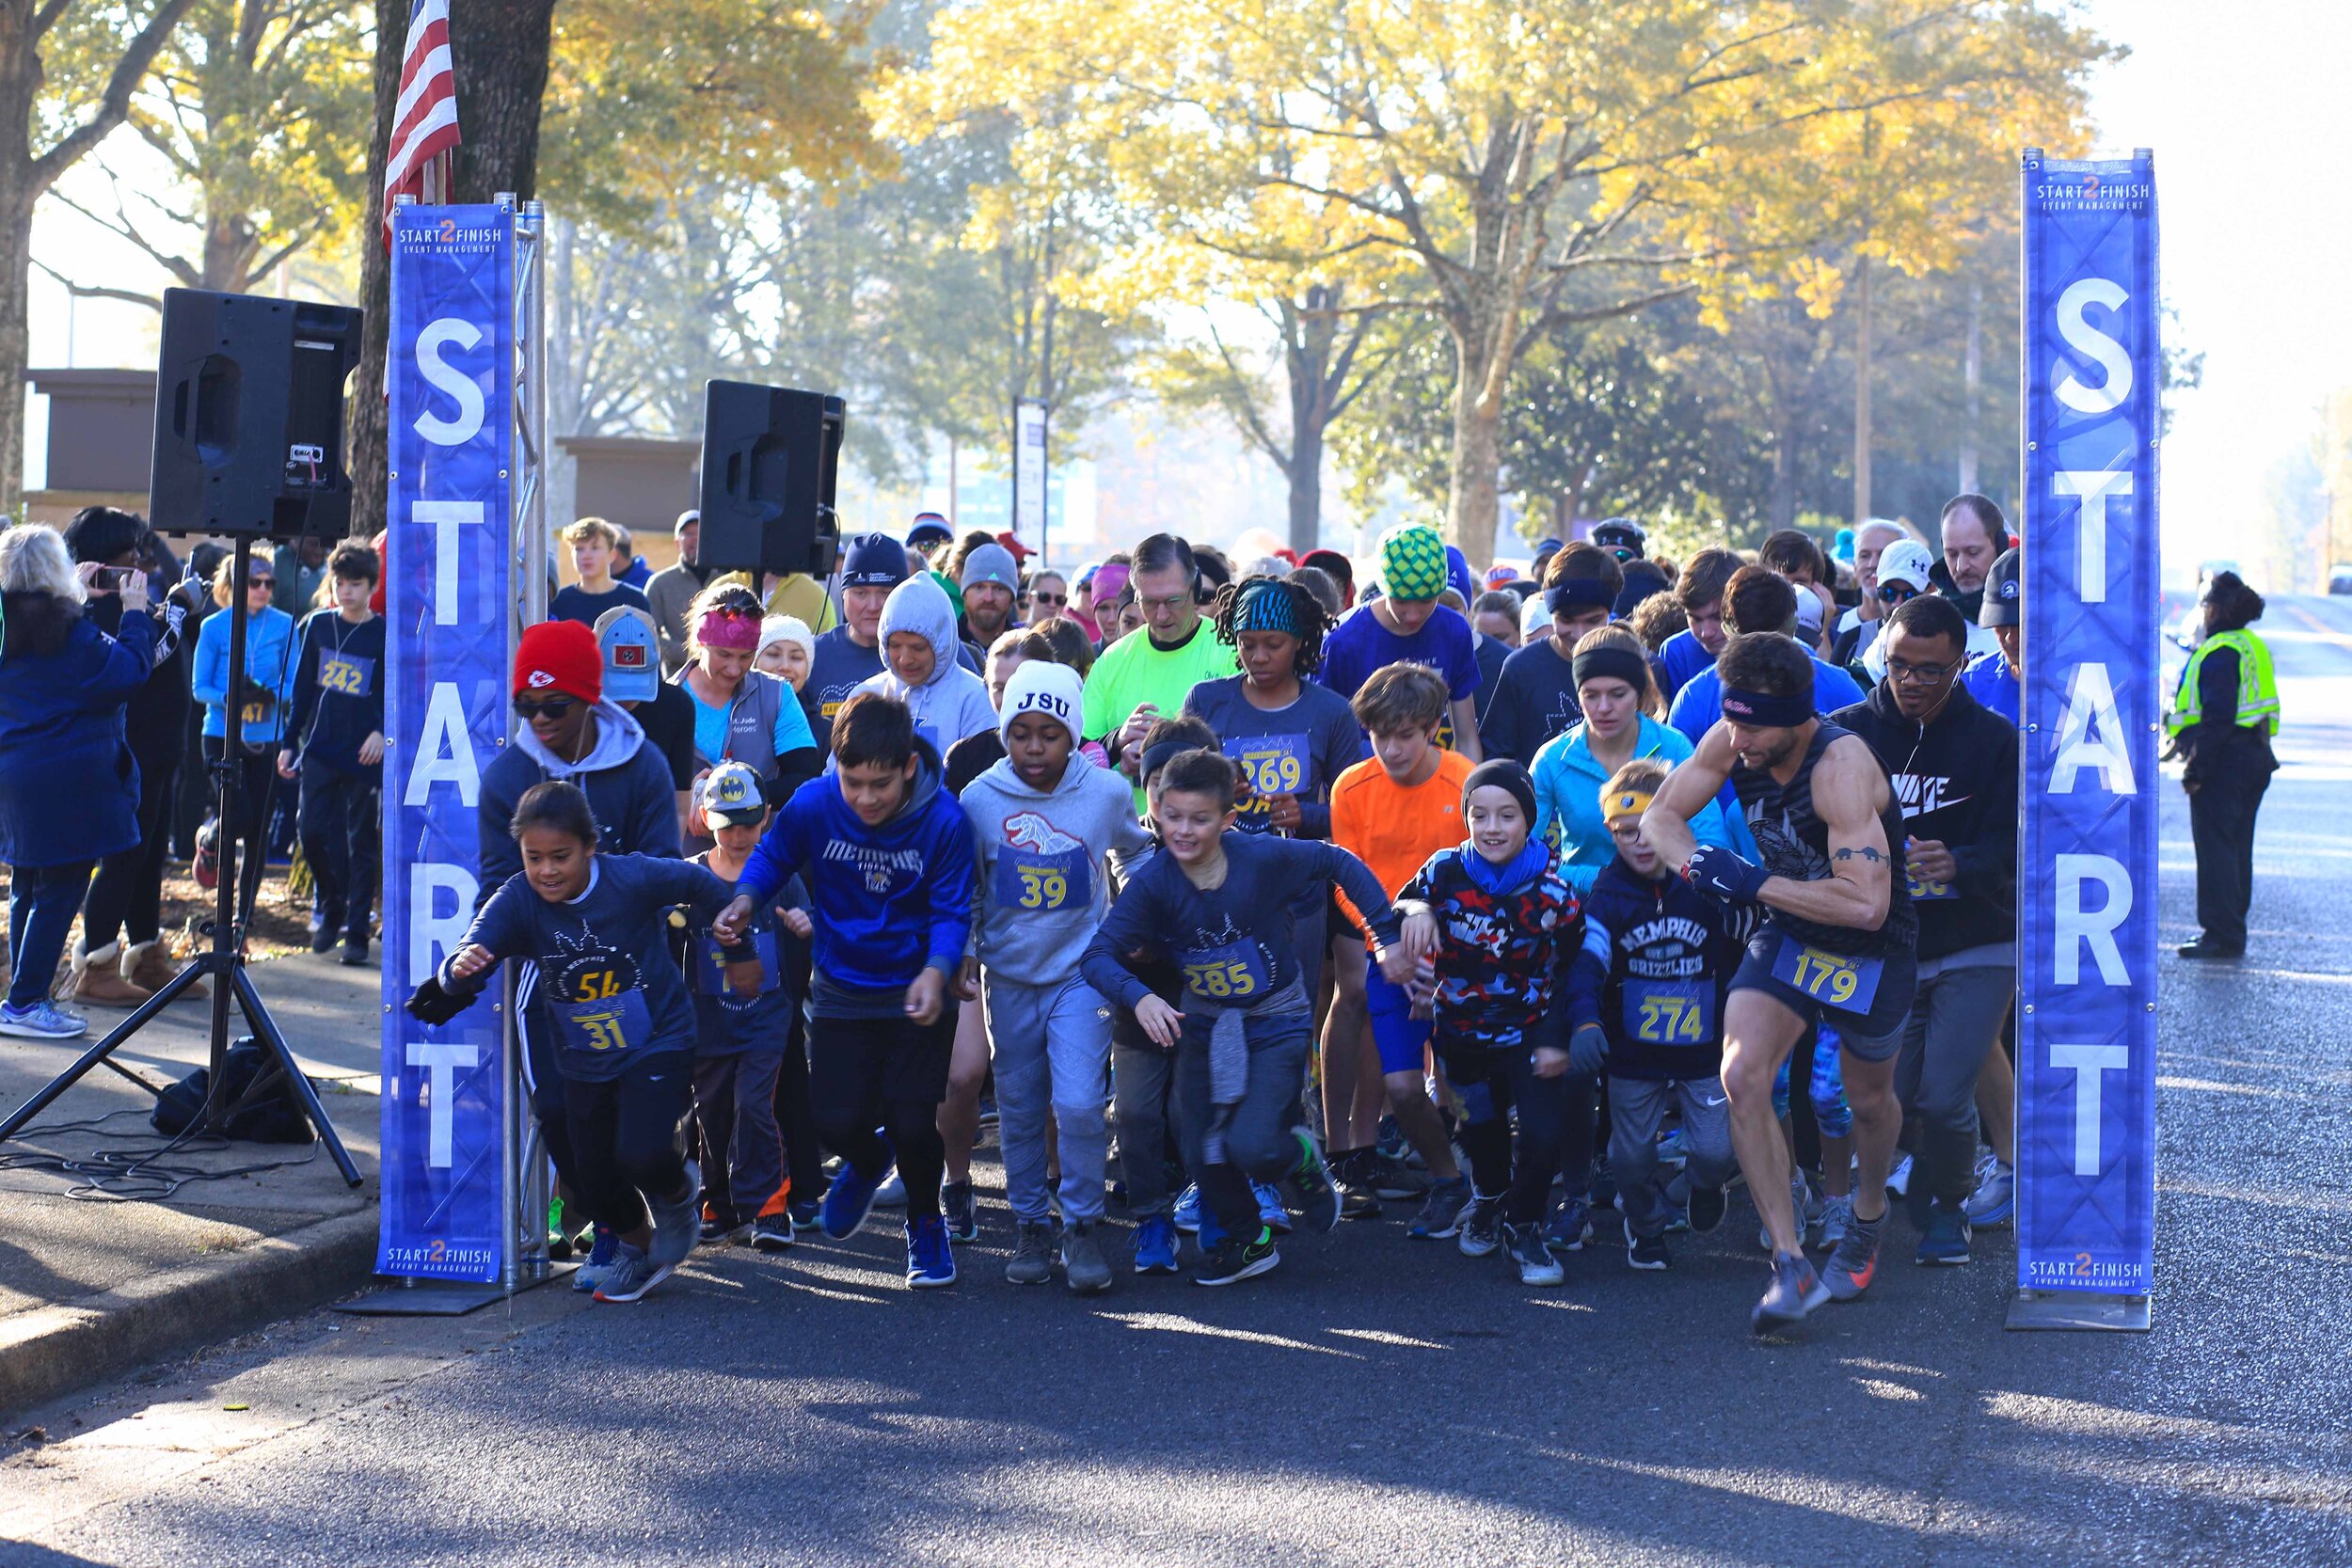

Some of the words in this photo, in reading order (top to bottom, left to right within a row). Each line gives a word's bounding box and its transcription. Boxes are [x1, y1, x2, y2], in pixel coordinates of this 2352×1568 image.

[2042, 200, 2072, 211] EVENT
[2077, 200, 2143, 211] MANAGEMENT
[404, 245, 430, 254] EVENT
[436, 245, 496, 254] MANAGEMENT
[322, 663, 362, 693] 242
[1018, 692, 1070, 719] JSU
[404, 317, 485, 1168] START
[2047, 277, 2137, 1176] START
[1892, 773, 1950, 806] NIKE
[1020, 875, 1067, 909] 39
[1619, 916, 1708, 953] MEMPHIS
[1184, 962, 1255, 997] 285
[1629, 955, 1703, 977] GRIZZLIES
[1792, 954, 1857, 1004] 179
[580, 1019, 628, 1050] 31
[1639, 1004, 1704, 1042] 274
[390, 1262, 418, 1271] EVENT
[423, 1263, 485, 1274] MANAGEMENT
[2035, 1277, 2064, 1286] EVENT
[2070, 1278, 2136, 1287] MANAGEMENT
